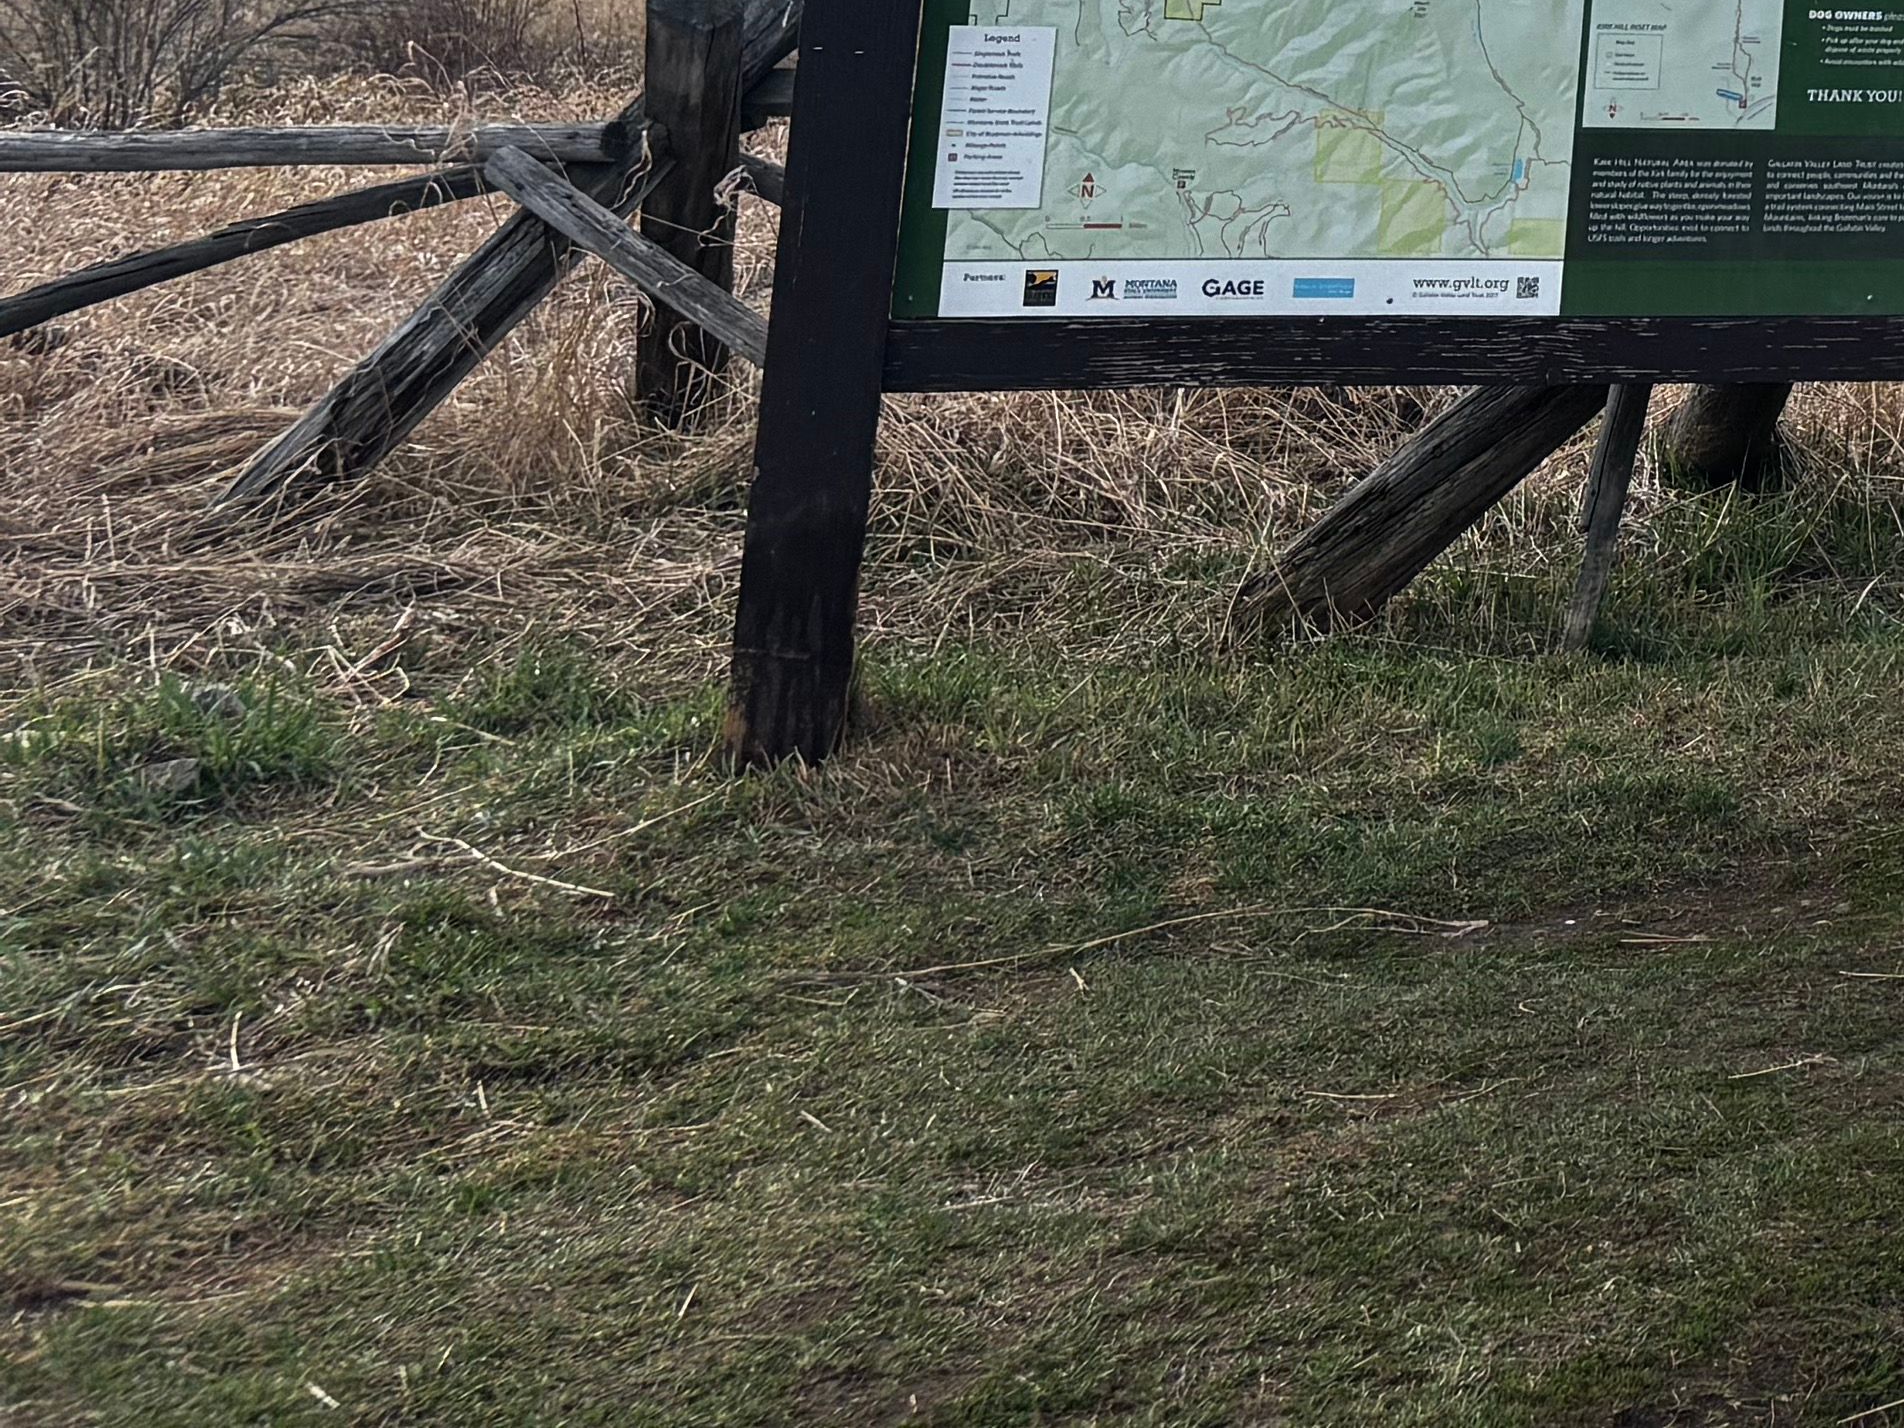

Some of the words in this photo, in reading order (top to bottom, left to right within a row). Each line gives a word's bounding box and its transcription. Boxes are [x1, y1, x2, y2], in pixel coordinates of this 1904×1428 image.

[1809, 10, 1832, 19] DOG
[1835, 11, 1883, 21] OWNERS
[984, 34, 1020, 43] Legend
[1807, 89, 1862, 102] THANK
[1867, 90, 1903, 103] YOU!
[1082, 186, 1094, 198] N
[1125, 279, 1177, 288] MONTANA
[1201, 279, 1264, 297] GAGE
[1412, 276, 1509, 291] www.gvlt.org
